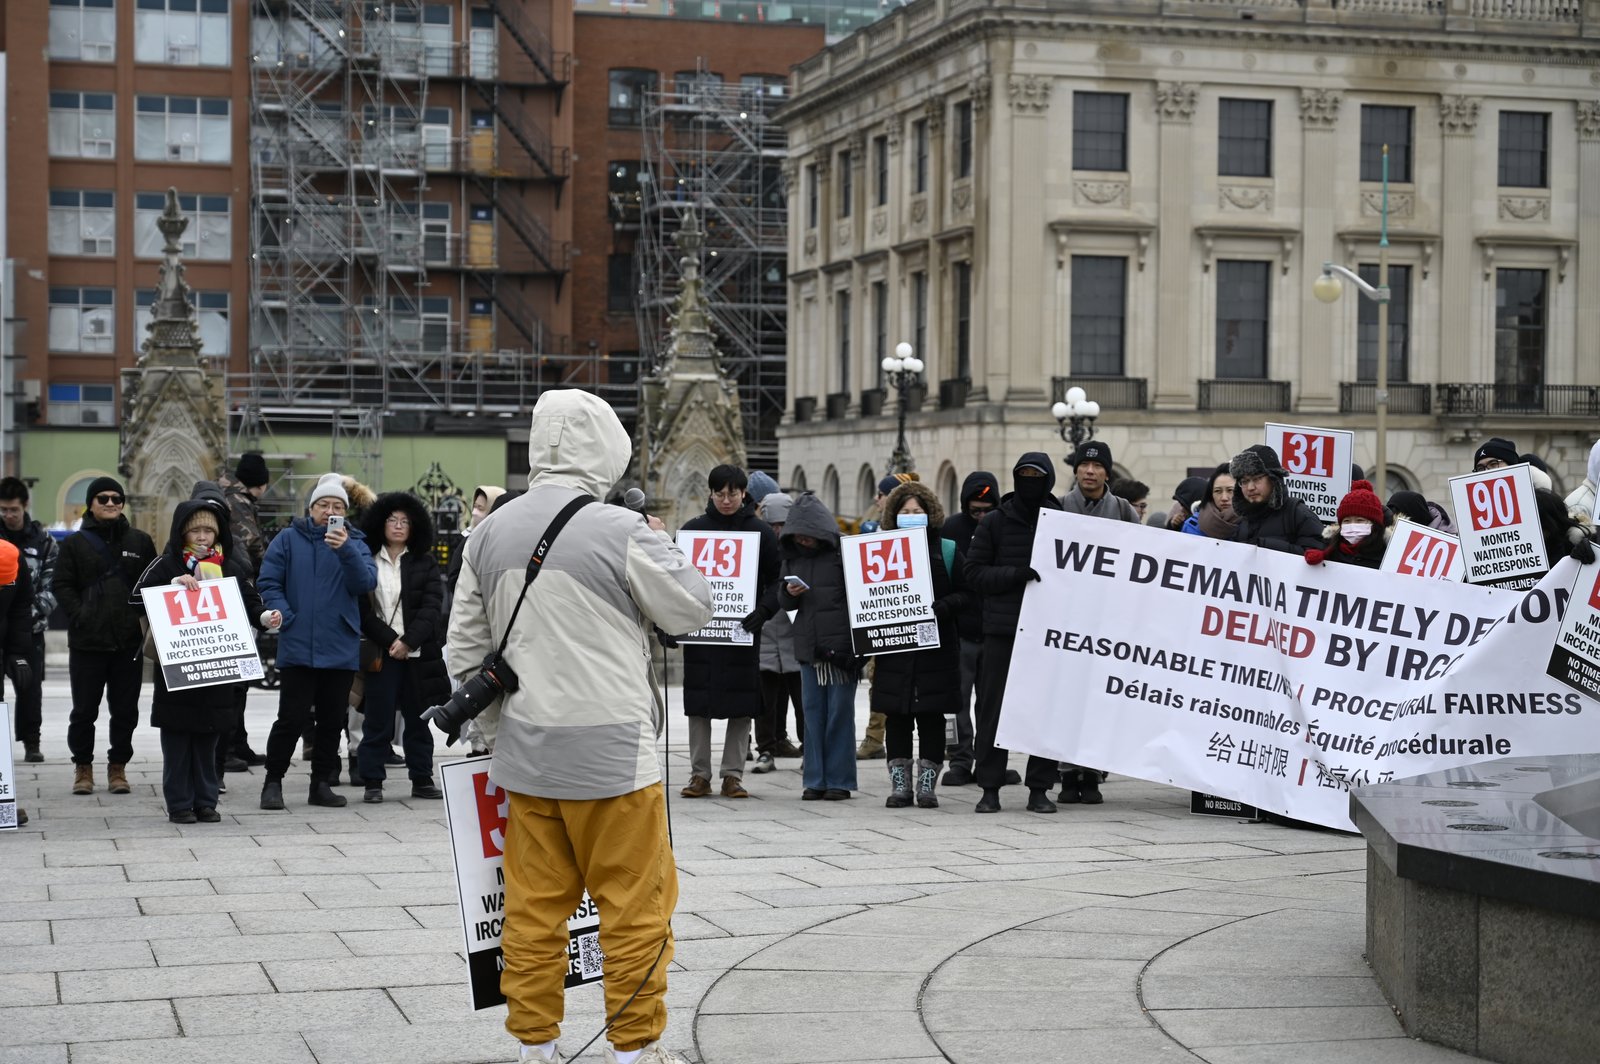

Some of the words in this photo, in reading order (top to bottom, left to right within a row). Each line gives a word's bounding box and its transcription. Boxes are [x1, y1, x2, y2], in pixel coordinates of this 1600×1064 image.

[1287, 433, 1327, 476] 31
[1285, 479, 1327, 492] MONTHS
[1317, 494, 1337, 505] FOR
[1472, 478, 1514, 528] 90
[1480, 530, 1520, 547] MONTHS
[696, 538, 737, 577] 43
[865, 538, 908, 582] 54
[1404, 536, 1450, 580] 40
[1473, 547, 1513, 562] WAITING
[1514, 542, 1534, 556] FOR
[1471, 564, 1497, 577] IRCC
[1493, 555, 1541, 574] RESPONSE
[710, 581, 734, 590] NTHS
[869, 583, 909, 597] MONTHS
[1054, 538, 1121, 578] WE
[1129, 552, 1272, 607] DEMAND
[1274, 581, 1288, 614] A
[1295, 585, 1440, 642] TIMELY
[173, 587, 220, 625] 14
[725, 593, 744, 602] FOR
[860, 596, 900, 610] WAITING
[902, 594, 921, 605] FOR
[856, 613, 877, 623] IRCC
[878, 605, 929, 620] RESPONSE
[179, 624, 225, 637] MONTHS
[700, 629, 733, 638] RESULTS
[867, 629, 879, 638] NO
[1200, 605, 1316, 659] DELAYED
[1324, 633, 1380, 672] BY
[170, 636, 215, 649] WAITING
[218, 633, 239, 643] FOR
[872, 638, 885, 648] NO
[885, 635, 918, 646] RESULTS
[1563, 632, 1587, 652] IRCC
[166, 649, 191, 661] IRCC
[192, 642, 249, 657] RESPONSE
[181, 664, 194, 673] NO
[1044, 628, 1216, 679] REASONABLE
[1220, 661, 1293, 700] TIMELINES
[1444, 692, 1583, 715] FAIRNESS
[1567, 656, 1580, 670] NO
[187, 672, 201, 681] NO
[201, 667, 240, 679] RESULTS
[1567, 669, 1580, 683] NO
[1105, 675, 1184, 709] Délais
[1189, 697, 1300, 736] raisonnables
[1307, 719, 1376, 756] Équité
[1375, 732, 1512, 761] procédurale
[1206, 731, 1289, 778] 给出时限
[1205, 800, 1214, 809] NO
[1215, 801, 1241, 811] RESULTS
